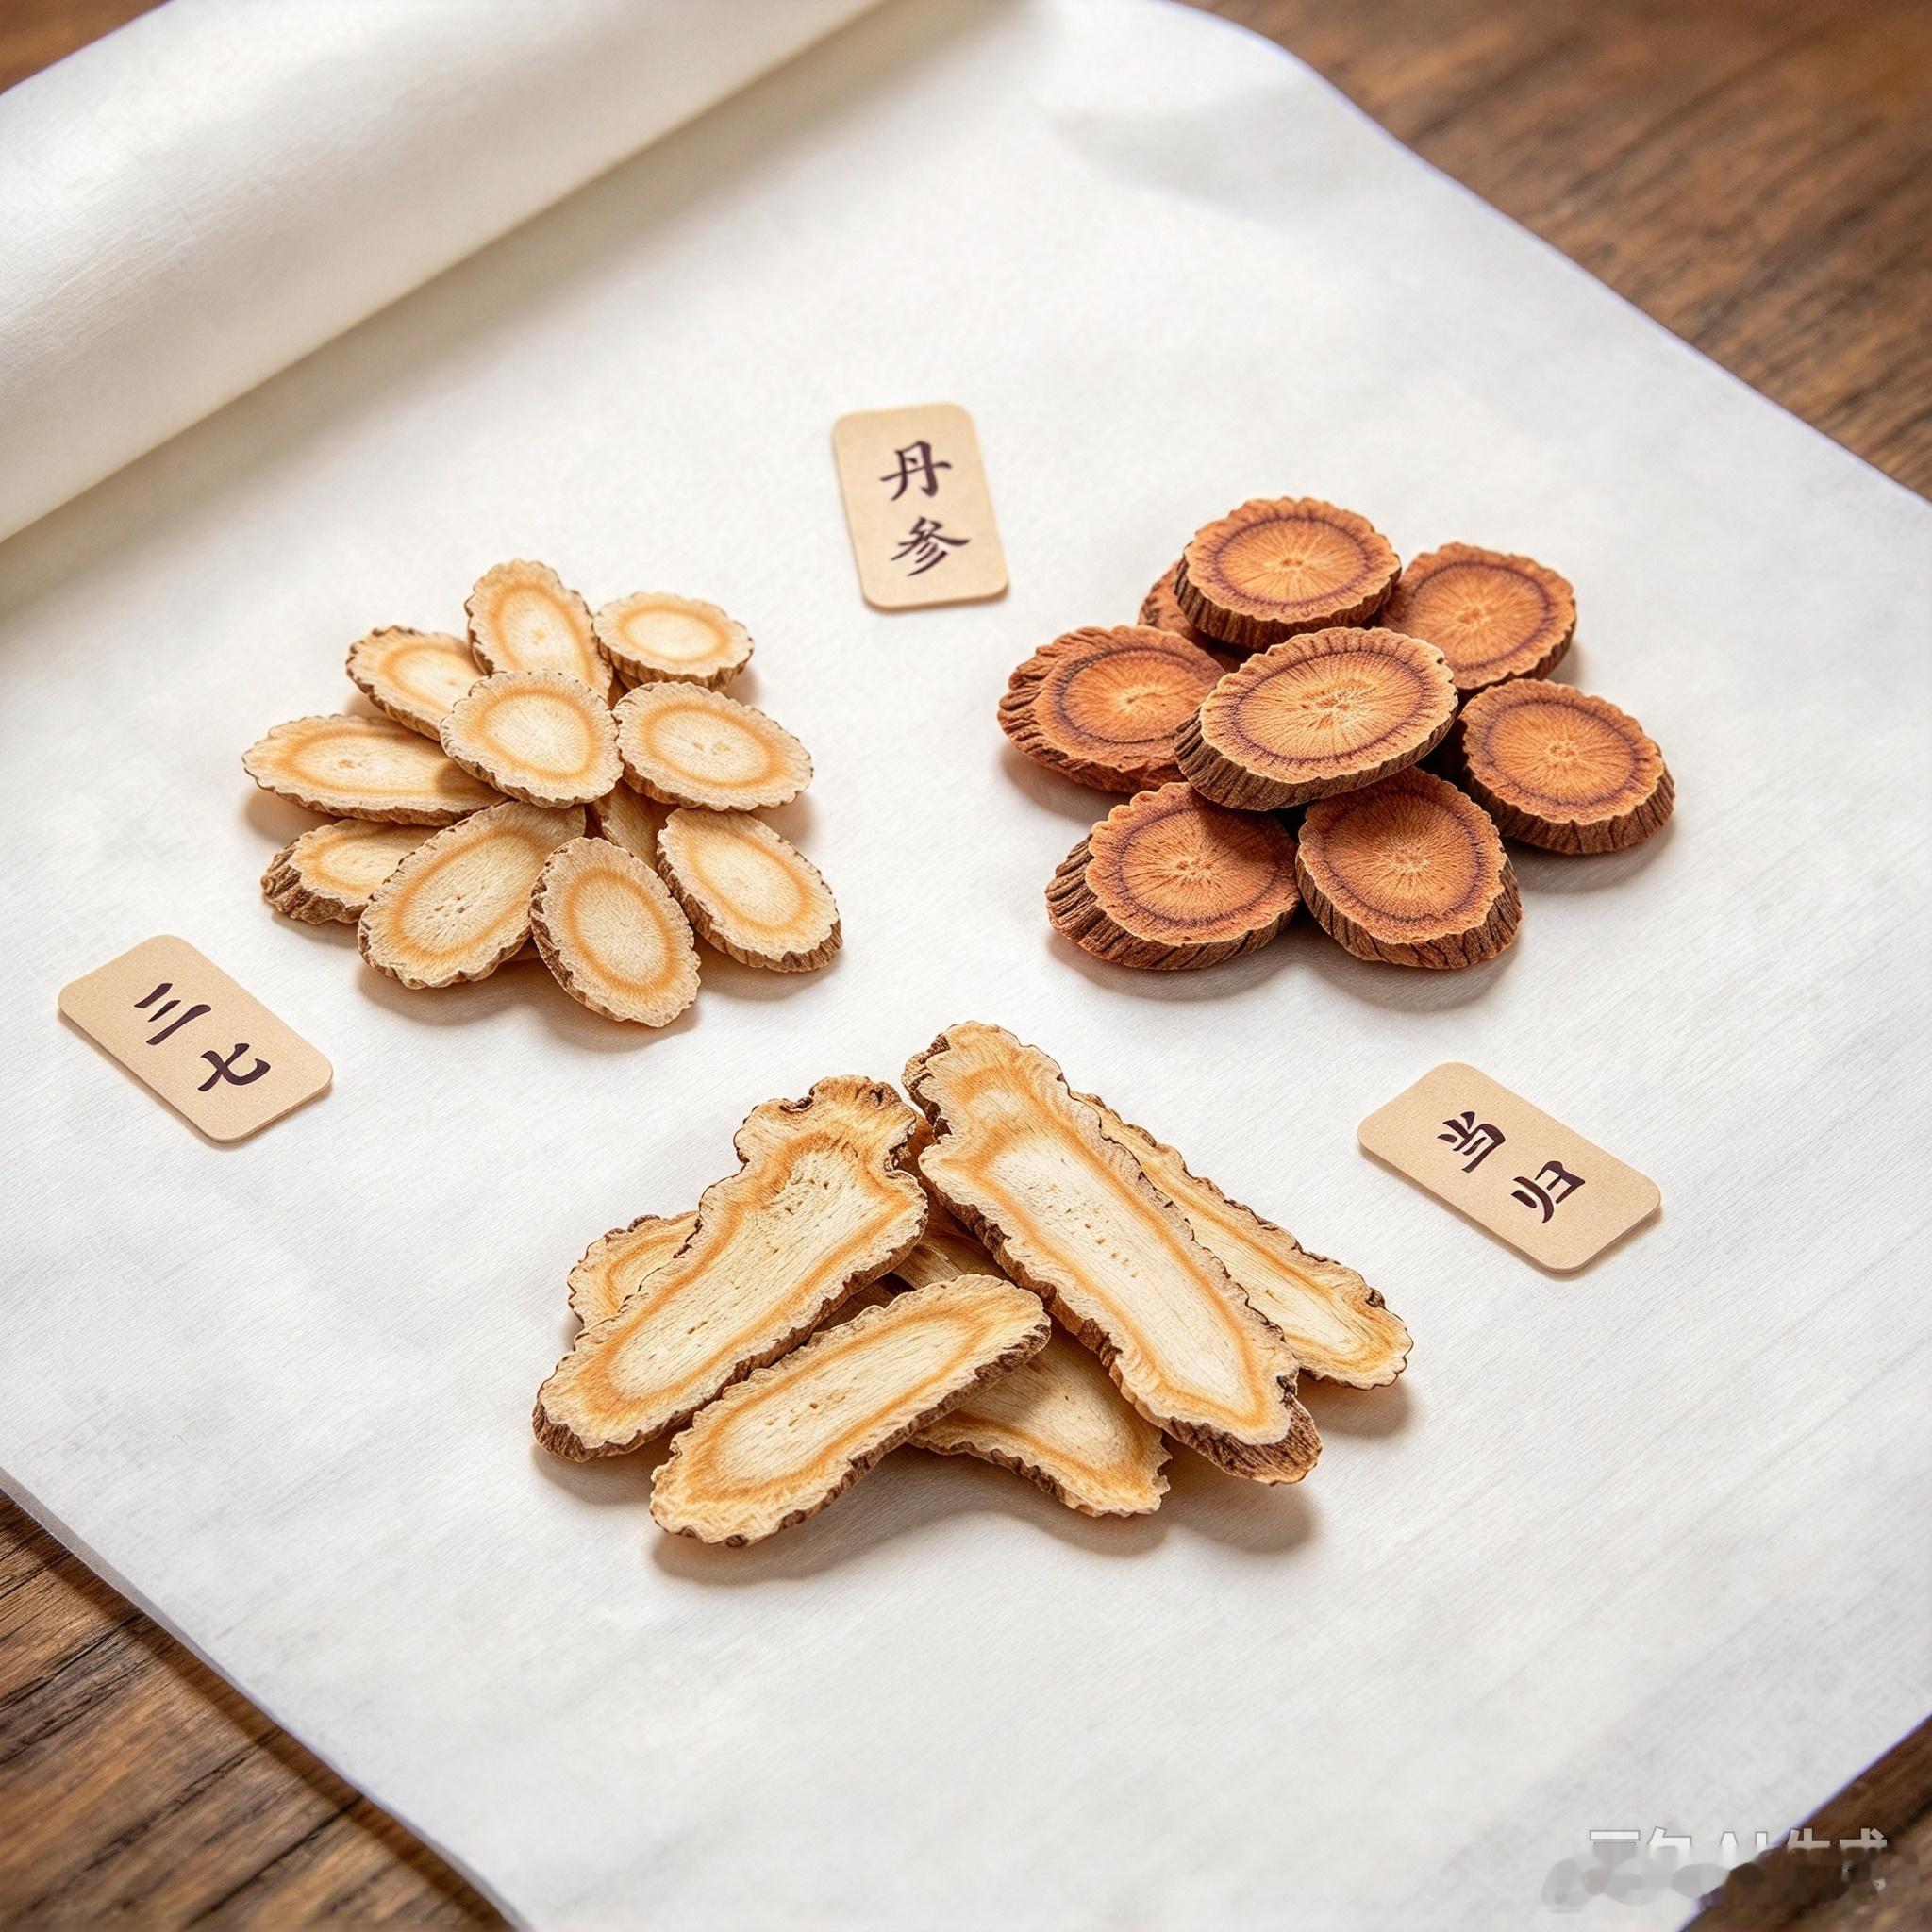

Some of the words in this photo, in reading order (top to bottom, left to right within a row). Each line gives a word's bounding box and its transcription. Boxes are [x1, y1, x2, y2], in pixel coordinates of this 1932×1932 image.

[880, 440, 970, 578] 丹参
[133, 981, 272, 1093] 三七
[1436, 1110, 1587, 1224] 当归
